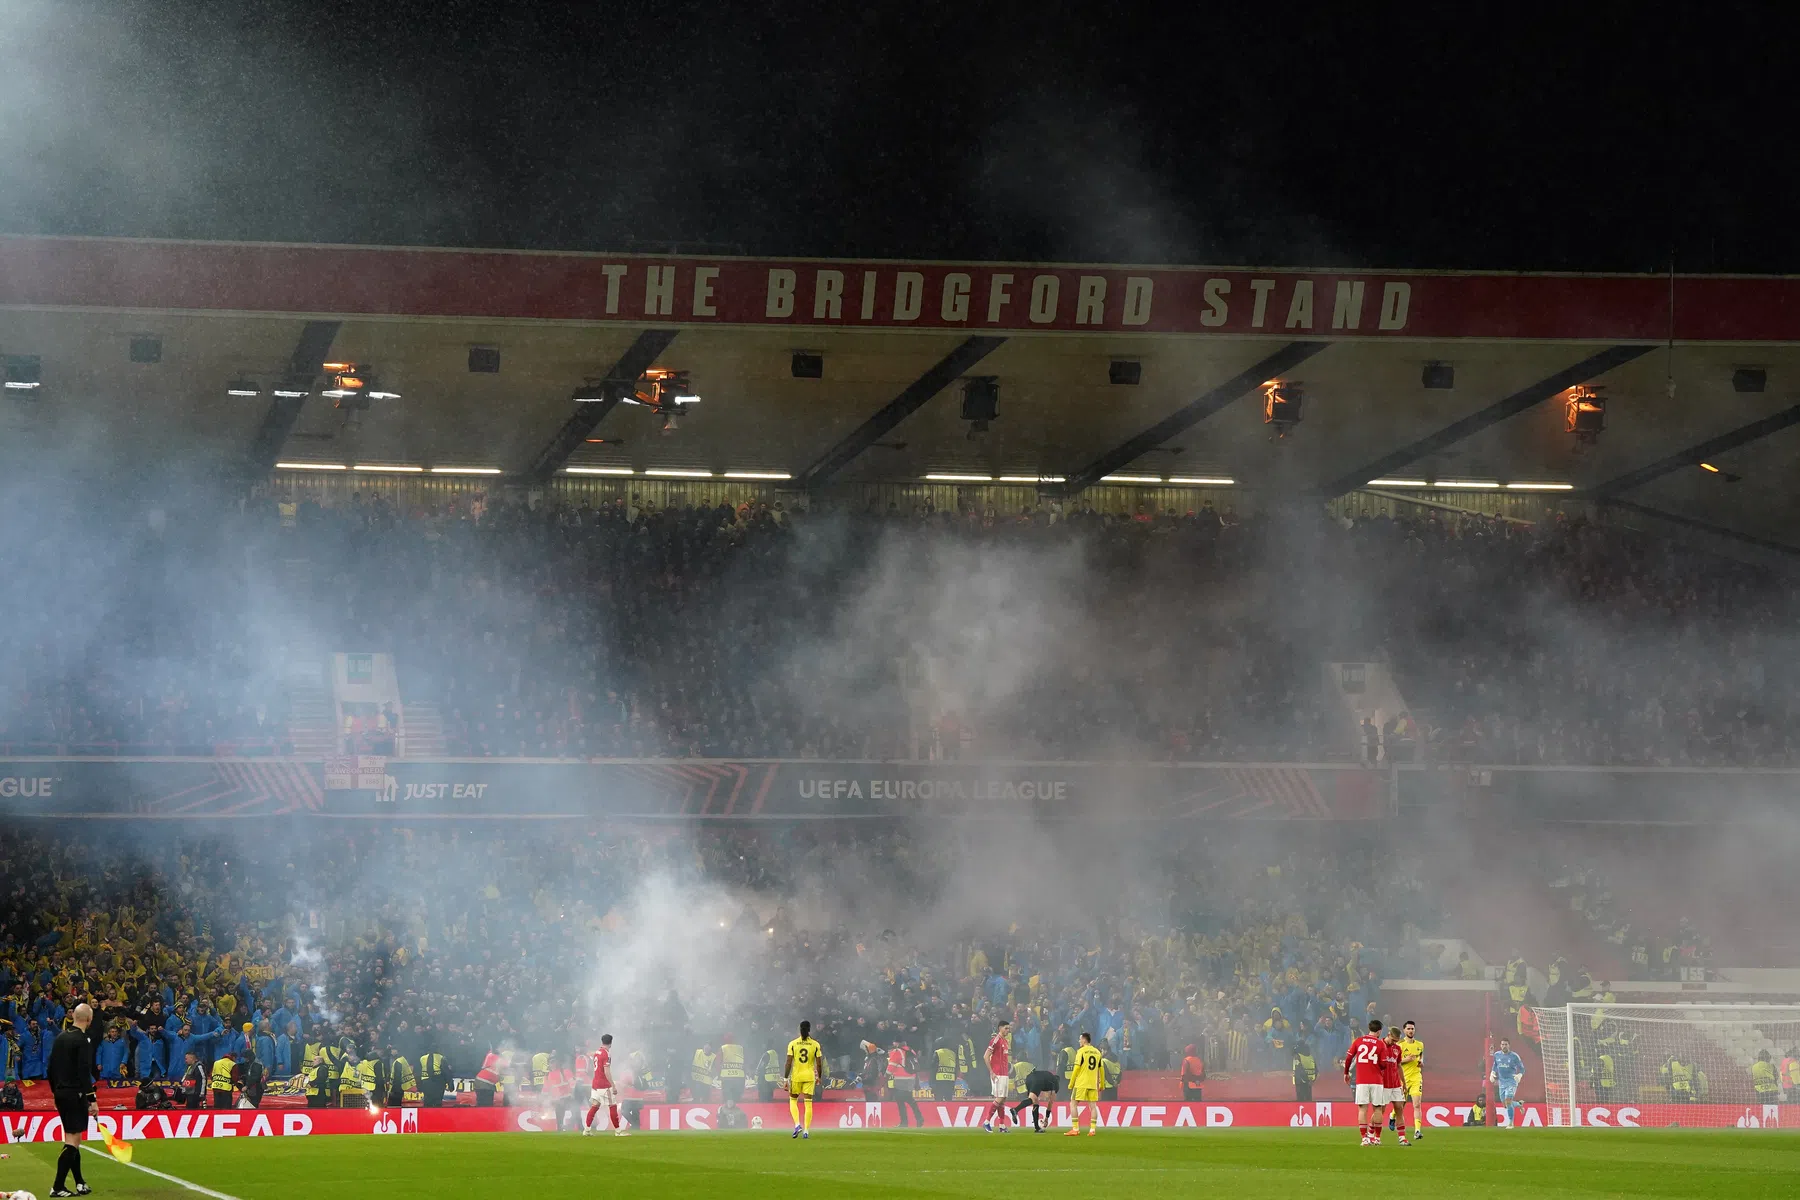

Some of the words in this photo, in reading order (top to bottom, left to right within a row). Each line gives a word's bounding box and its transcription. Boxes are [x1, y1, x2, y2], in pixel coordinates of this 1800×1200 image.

[602, 264, 720, 317] THE
[765, 268, 1154, 325] BRIDGFORD
[1200, 278, 1411, 330] STAND
[0, 777, 52, 797] GUE
[404, 783, 449, 800] JUST
[452, 783, 488, 799] EAT
[798, 779, 864, 799] UEFA
[870, 780, 967, 800] EUROPA
[974, 781, 1067, 800] LEAGUE
[798, 1048, 808, 1063] 3
[1088, 1055, 1097, 1070] 9
[1357, 1044, 1378, 1065] 24
